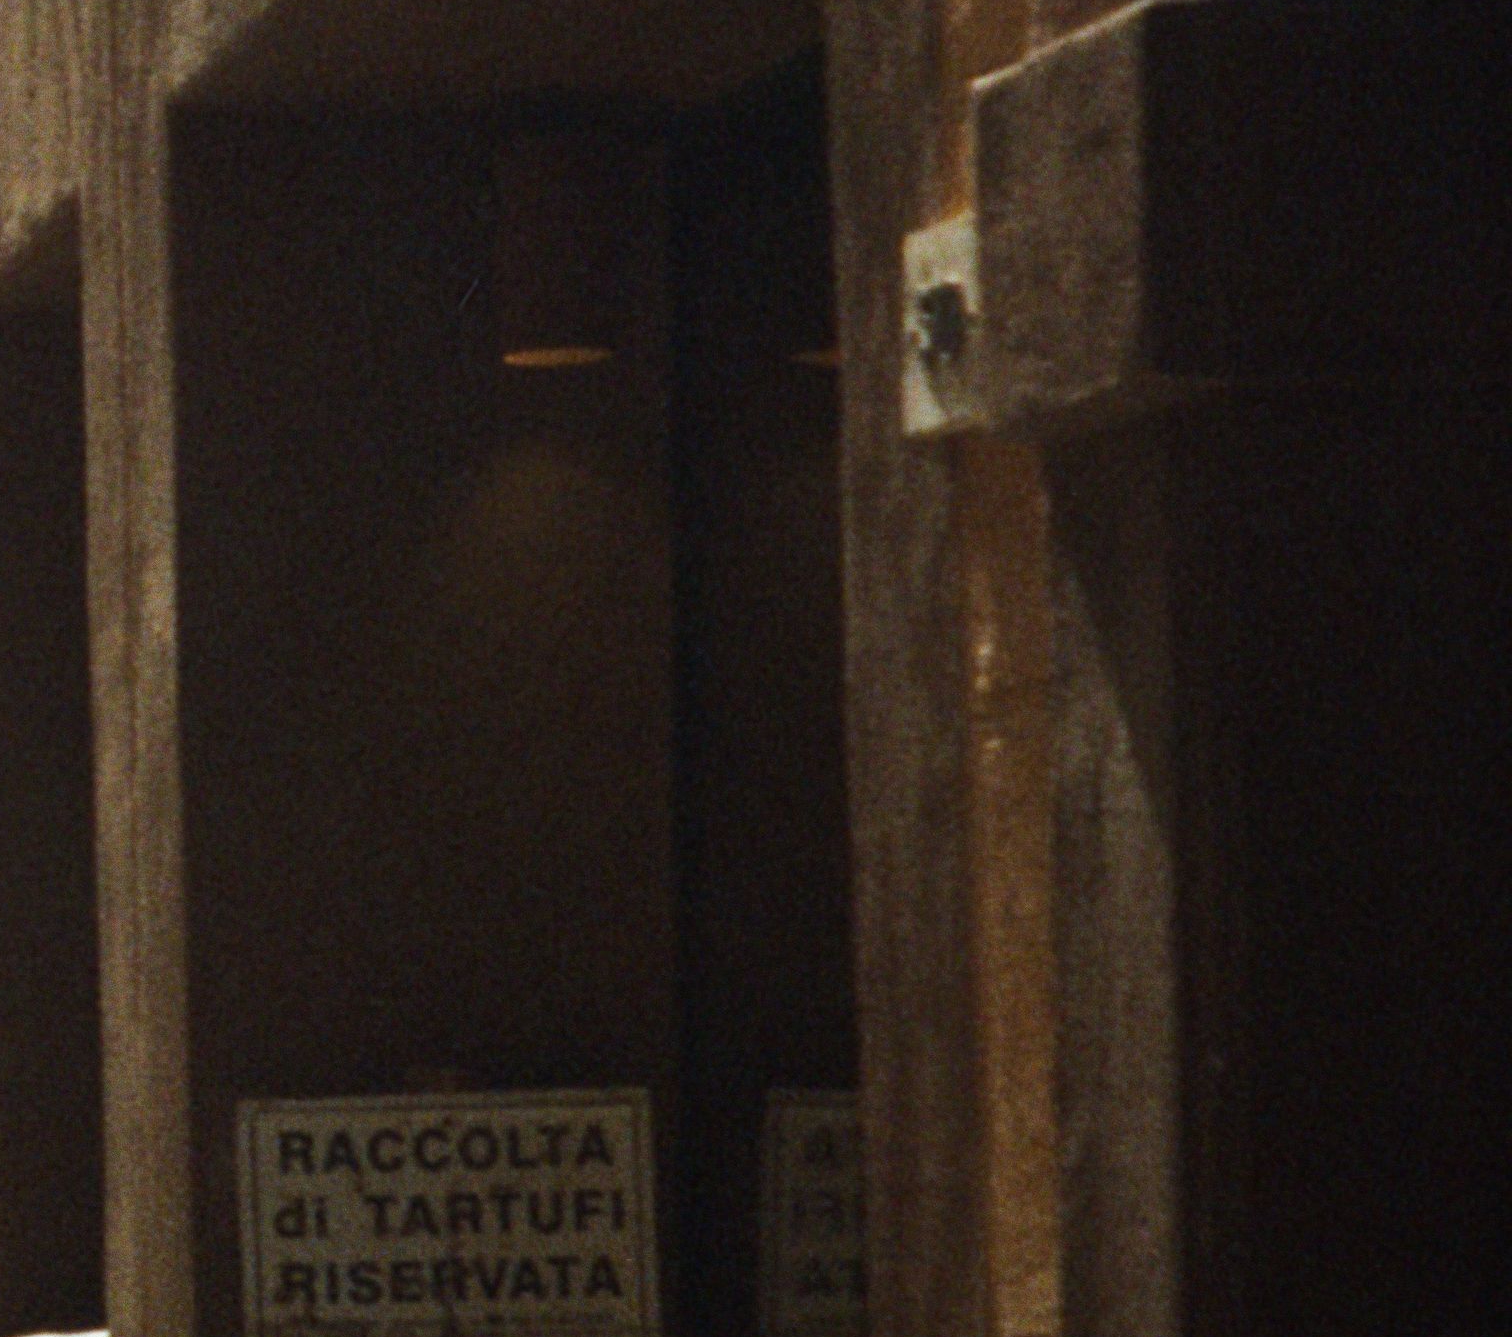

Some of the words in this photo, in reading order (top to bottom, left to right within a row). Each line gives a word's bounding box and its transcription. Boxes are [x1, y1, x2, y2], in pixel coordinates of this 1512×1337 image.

[276, 1124, 615, 1175] RACCOLTA
[274, 1194, 328, 1239] di
[365, 1188, 627, 1237] TARTUFI
[274, 1255, 626, 1304] RISERVATA
